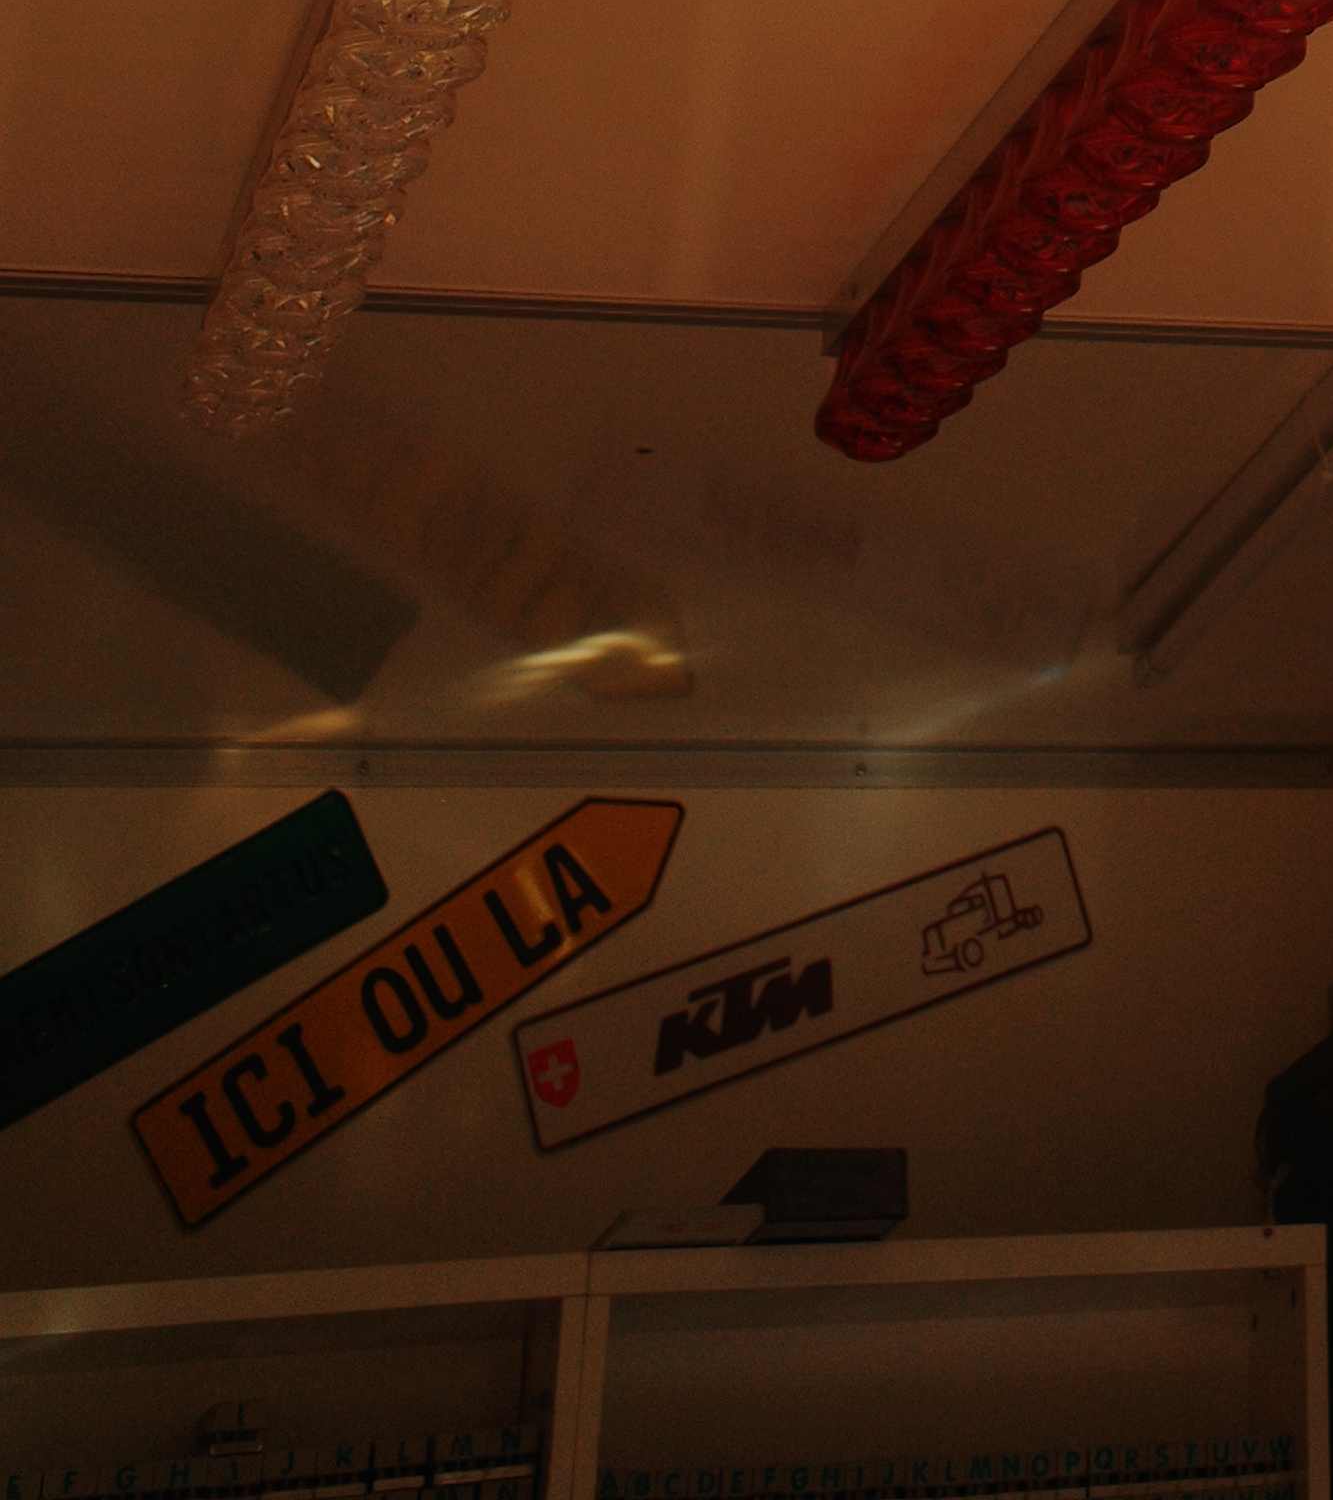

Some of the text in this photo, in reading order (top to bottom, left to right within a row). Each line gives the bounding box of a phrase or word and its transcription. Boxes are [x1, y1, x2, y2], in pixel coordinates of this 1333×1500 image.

[178, 842, 611, 1190] ICI OU LA
[653, 954, 833, 1076] KTM
